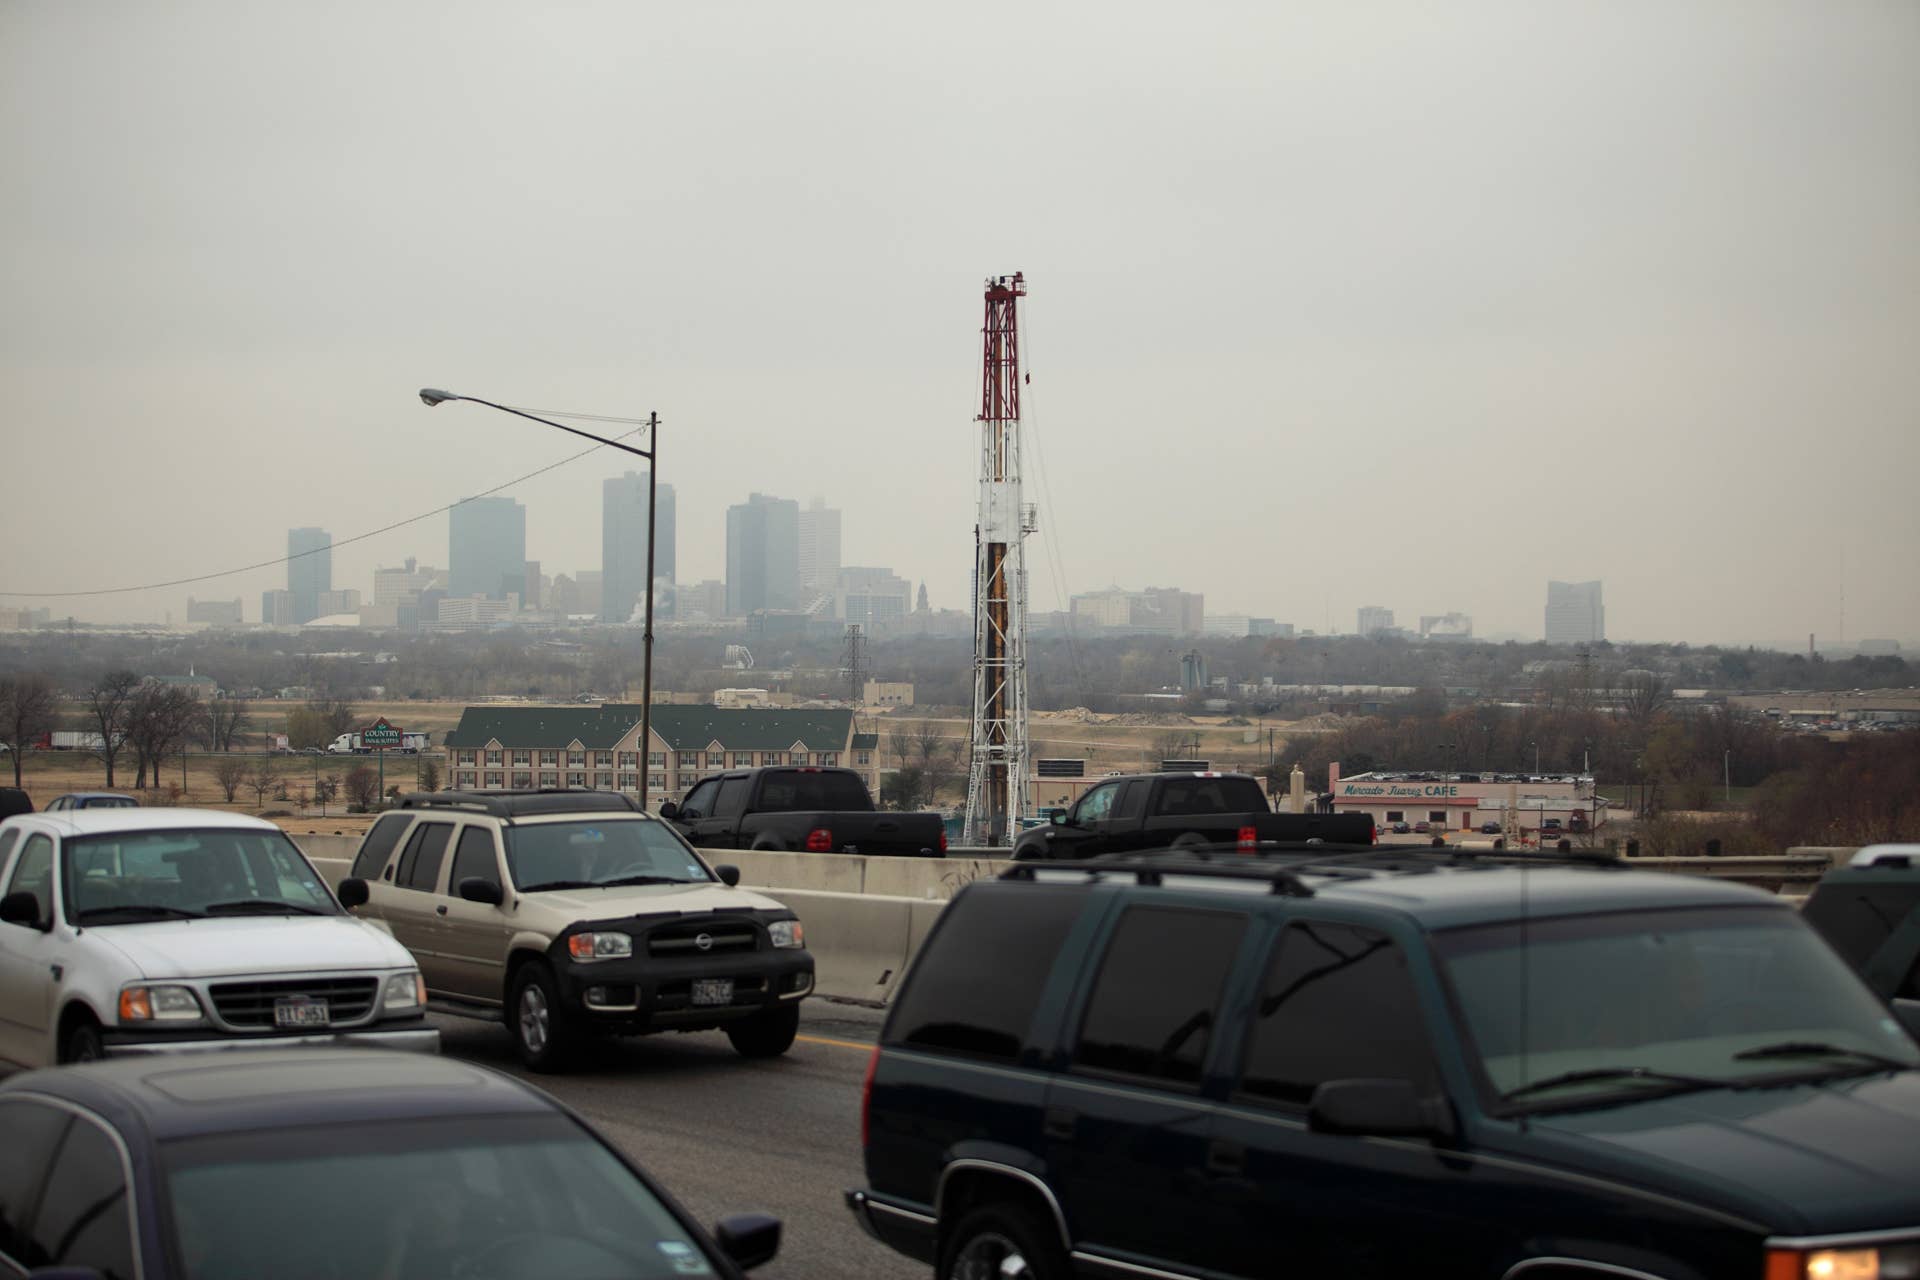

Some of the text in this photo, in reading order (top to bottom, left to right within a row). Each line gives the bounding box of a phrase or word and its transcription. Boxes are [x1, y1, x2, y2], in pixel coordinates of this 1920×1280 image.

[1344, 785, 1457, 797] Mercado Juarez CAFE
